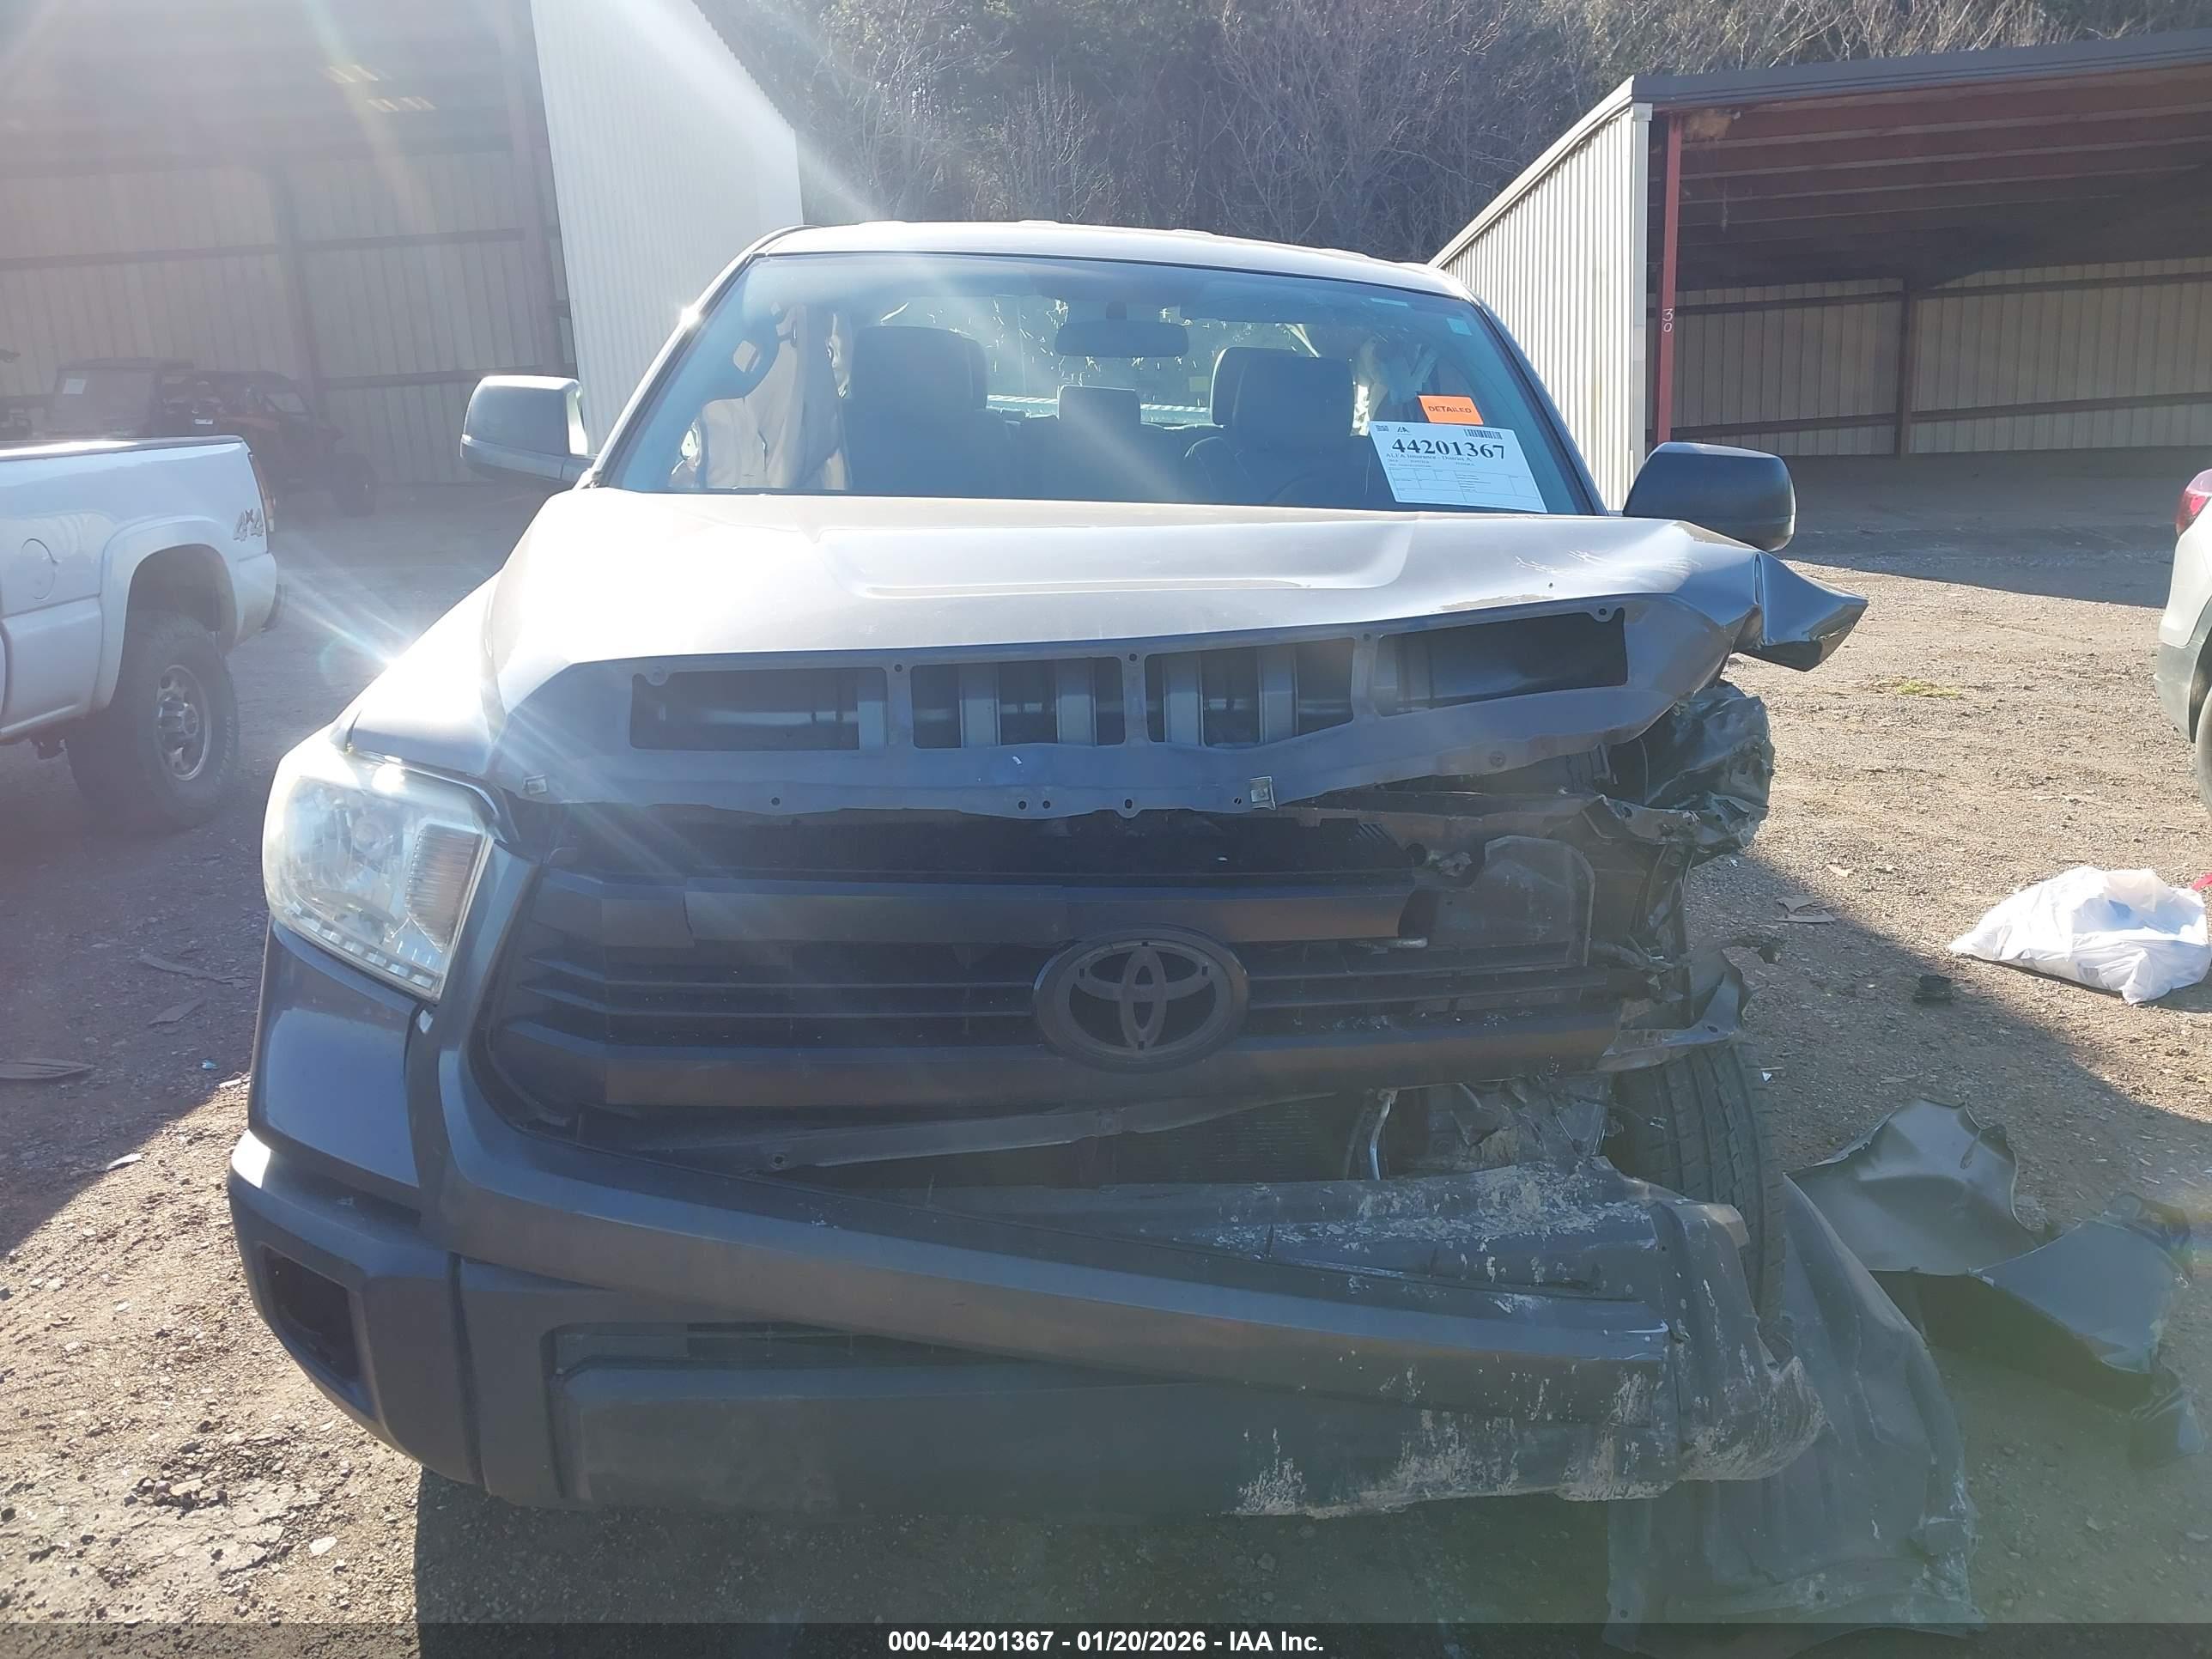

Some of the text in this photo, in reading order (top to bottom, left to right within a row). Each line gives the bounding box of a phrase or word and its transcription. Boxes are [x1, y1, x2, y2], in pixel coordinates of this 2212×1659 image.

[1662, 308, 1674, 332] 30
[1428, 405, 1472, 414] DETAILED
[1392, 438, 1504, 459] 44201367
